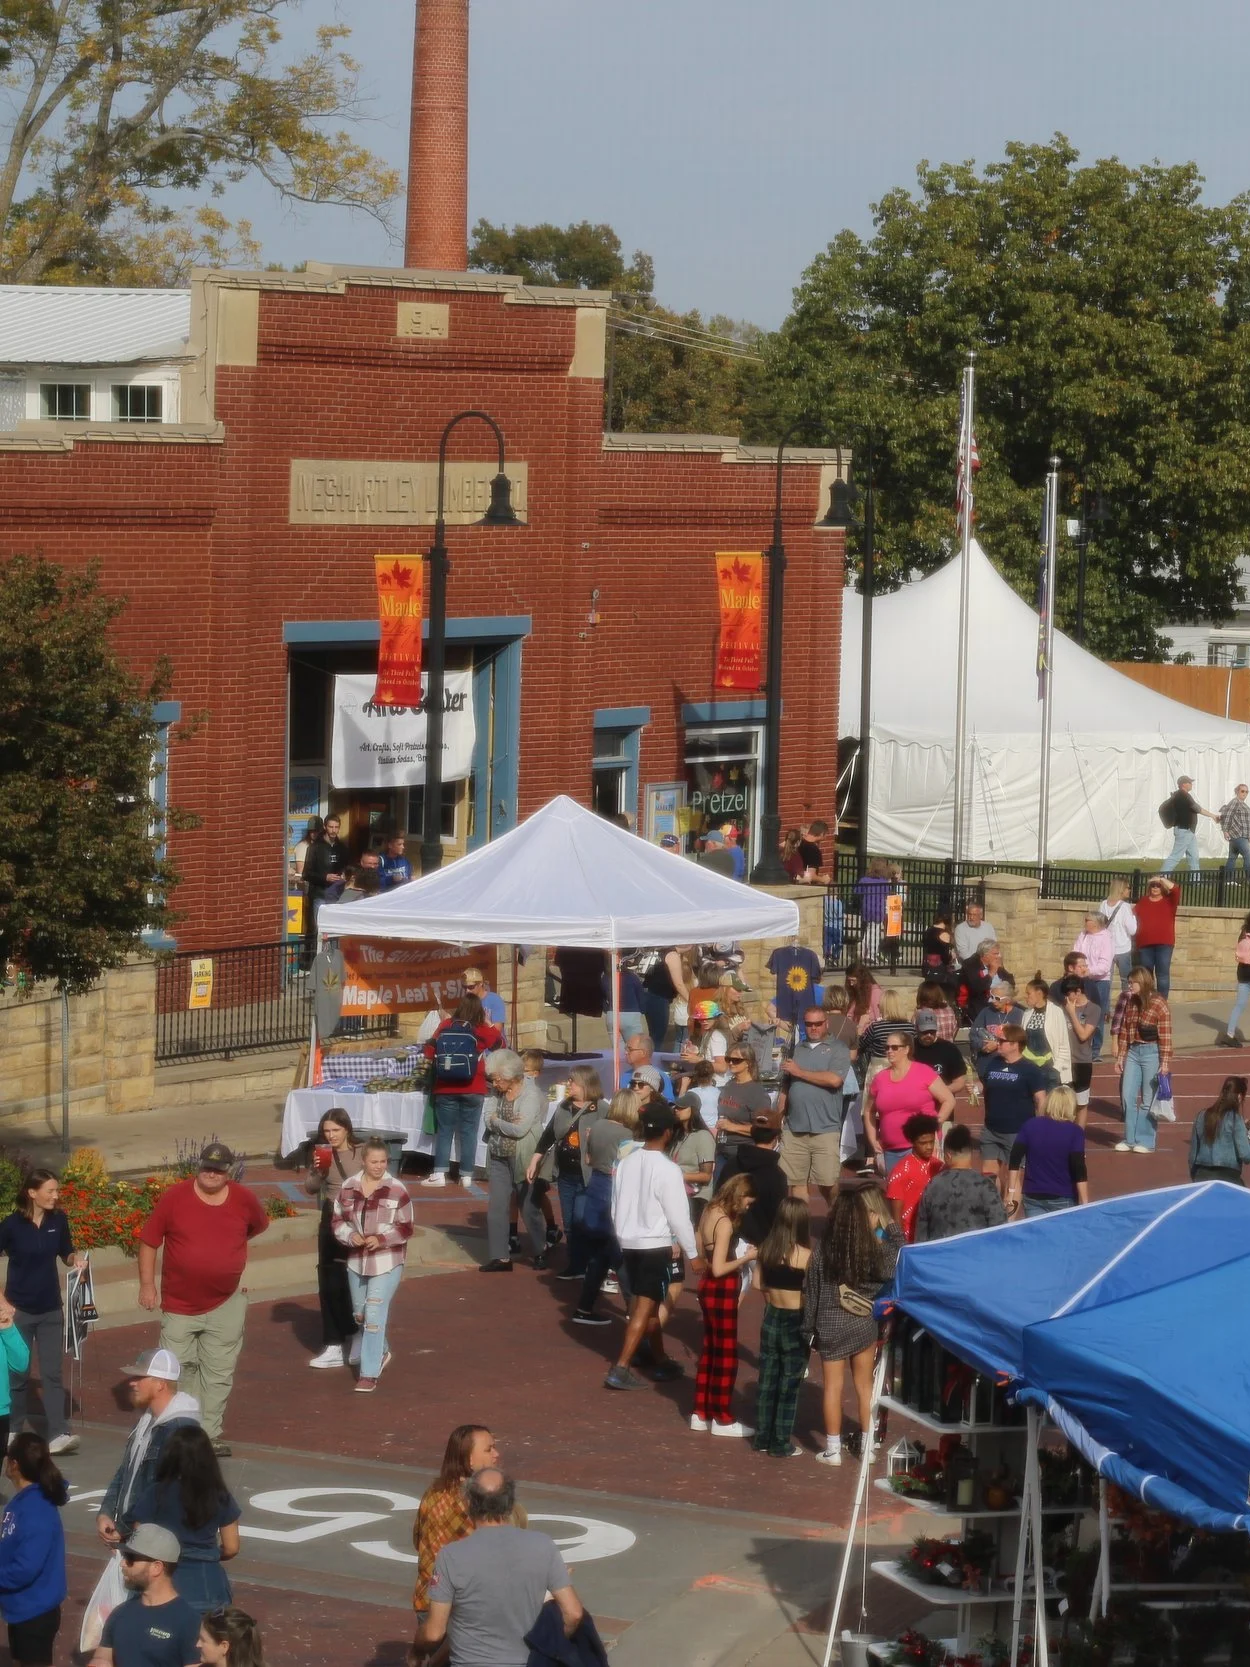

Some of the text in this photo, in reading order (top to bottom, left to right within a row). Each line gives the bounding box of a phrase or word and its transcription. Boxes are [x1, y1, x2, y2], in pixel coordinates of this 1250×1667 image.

[380, 594, 422, 618] Maple
[721, 588, 760, 613] Maple
[692, 785, 748, 814] Pretzel
[359, 944, 384, 963] The
[342, 984, 393, 1010] Maple
[395, 982, 429, 1004] Leaf
